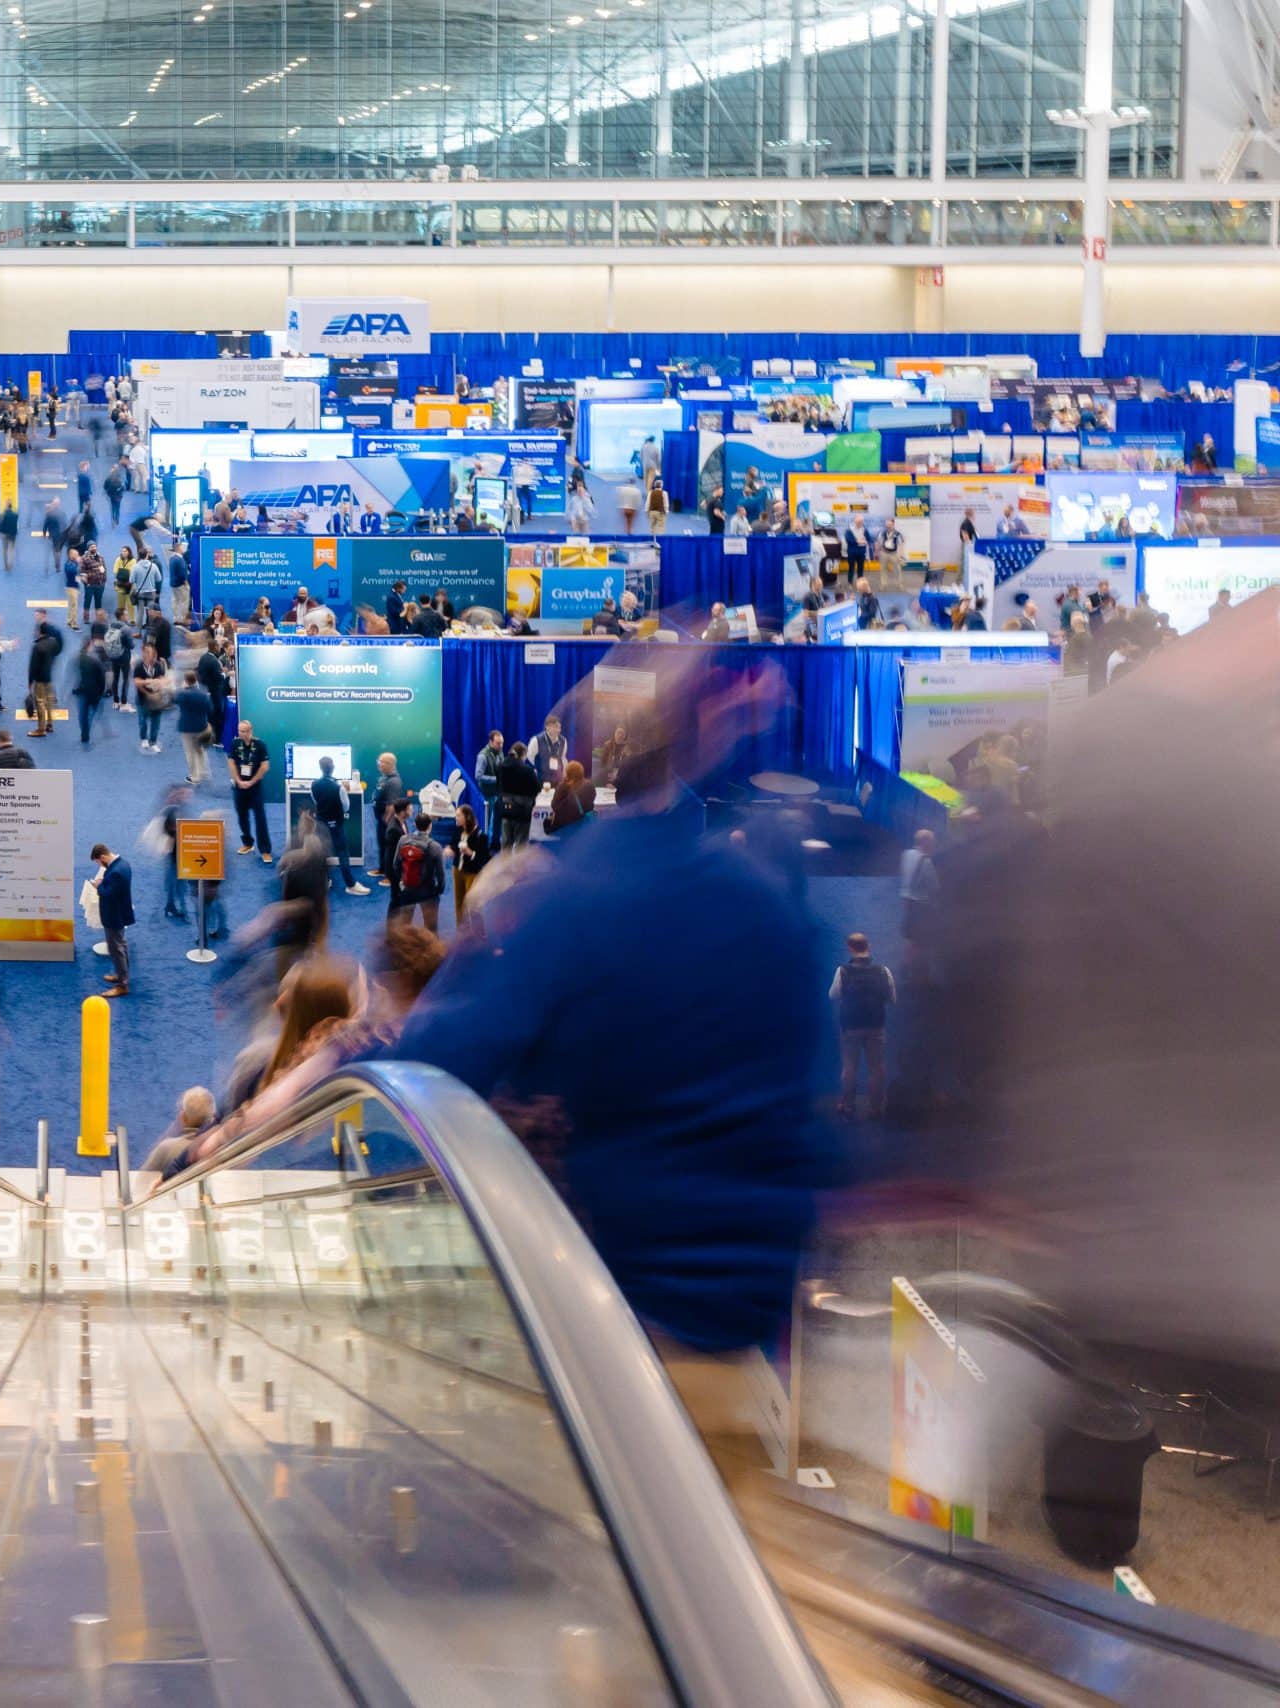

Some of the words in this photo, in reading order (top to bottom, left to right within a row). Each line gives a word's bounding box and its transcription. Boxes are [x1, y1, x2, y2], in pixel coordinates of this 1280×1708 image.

[338, 313, 411, 335] APA
[320, 336, 358, 344] SOLAR
[200, 388, 247, 397] RAYZON
[236, 551, 258, 559] Smart
[259, 551, 286, 559] Electric
[316, 548, 334, 560] RE
[258, 571, 277, 579] guide
[401, 569, 430, 577] ushering
[408, 577, 440, 587] Energy
[442, 577, 495, 586] Dominance
[350, 691, 381, 700] Recurring
[382, 691, 409, 699] Revenue
